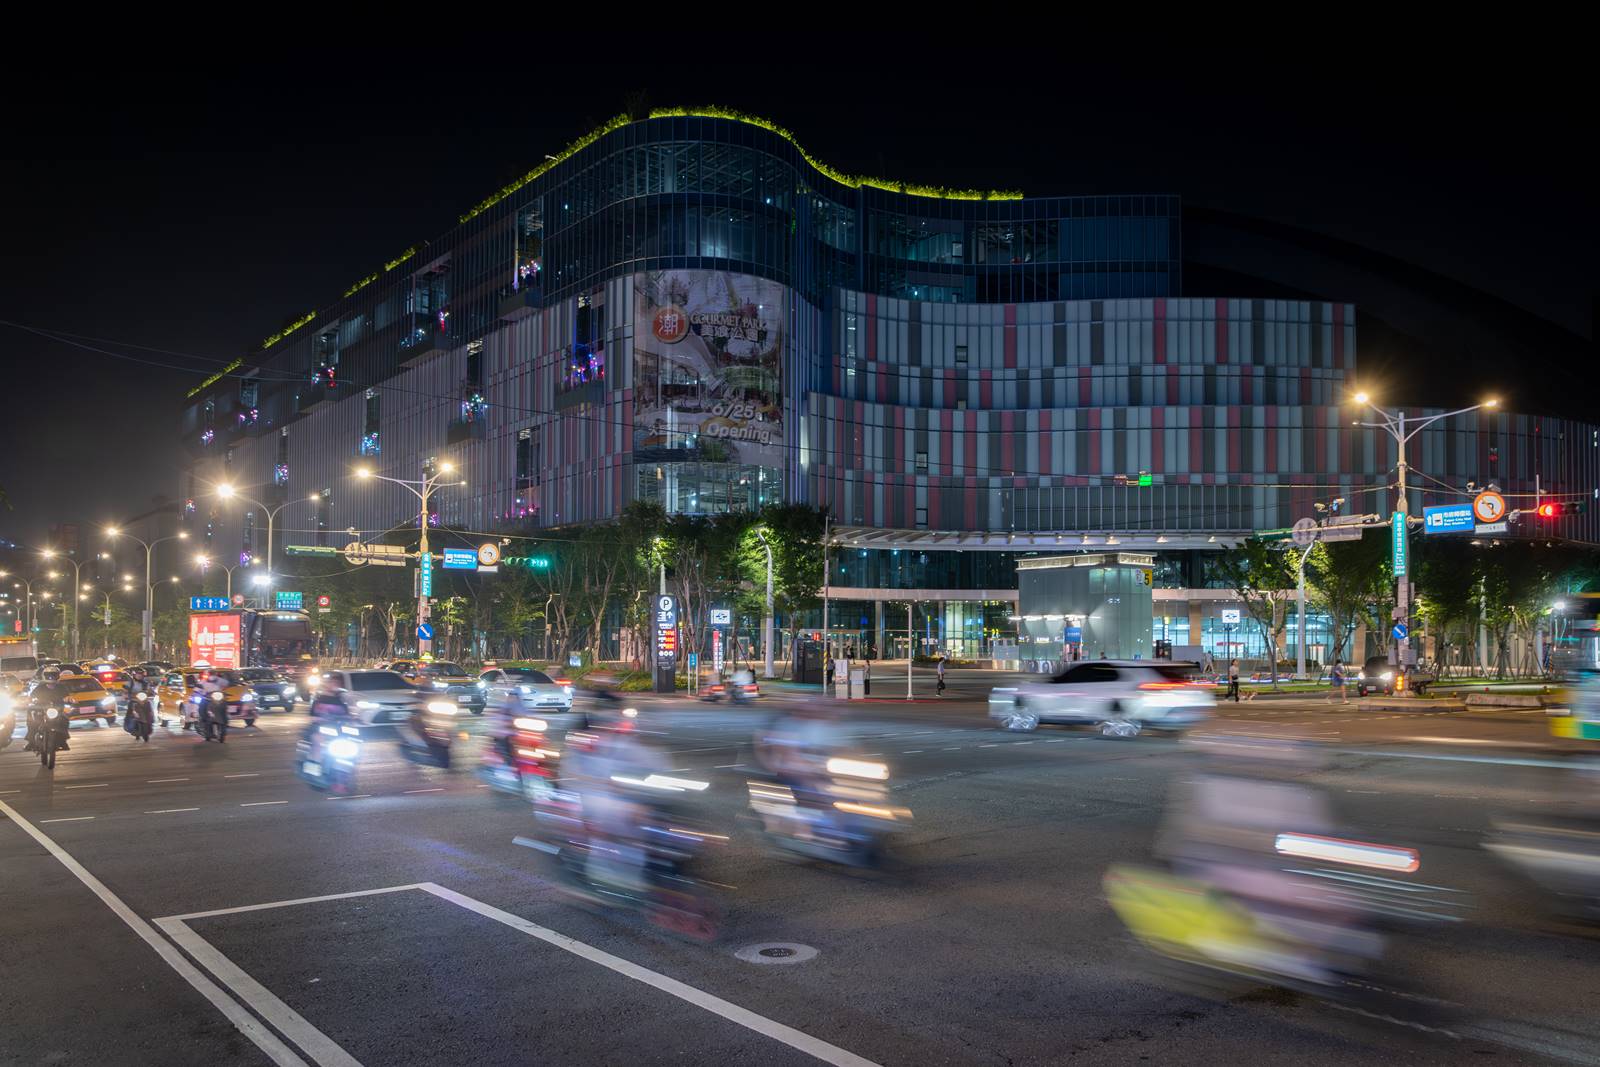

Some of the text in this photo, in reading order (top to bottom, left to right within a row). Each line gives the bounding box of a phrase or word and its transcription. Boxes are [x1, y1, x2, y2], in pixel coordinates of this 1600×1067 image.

[658, 313, 679, 337] 潮
[690, 312, 740, 326] GOURMET
[712, 402, 754, 419] 6/25
[707, 422, 771, 443] Opening
[1144, 573, 1149, 585] 5
